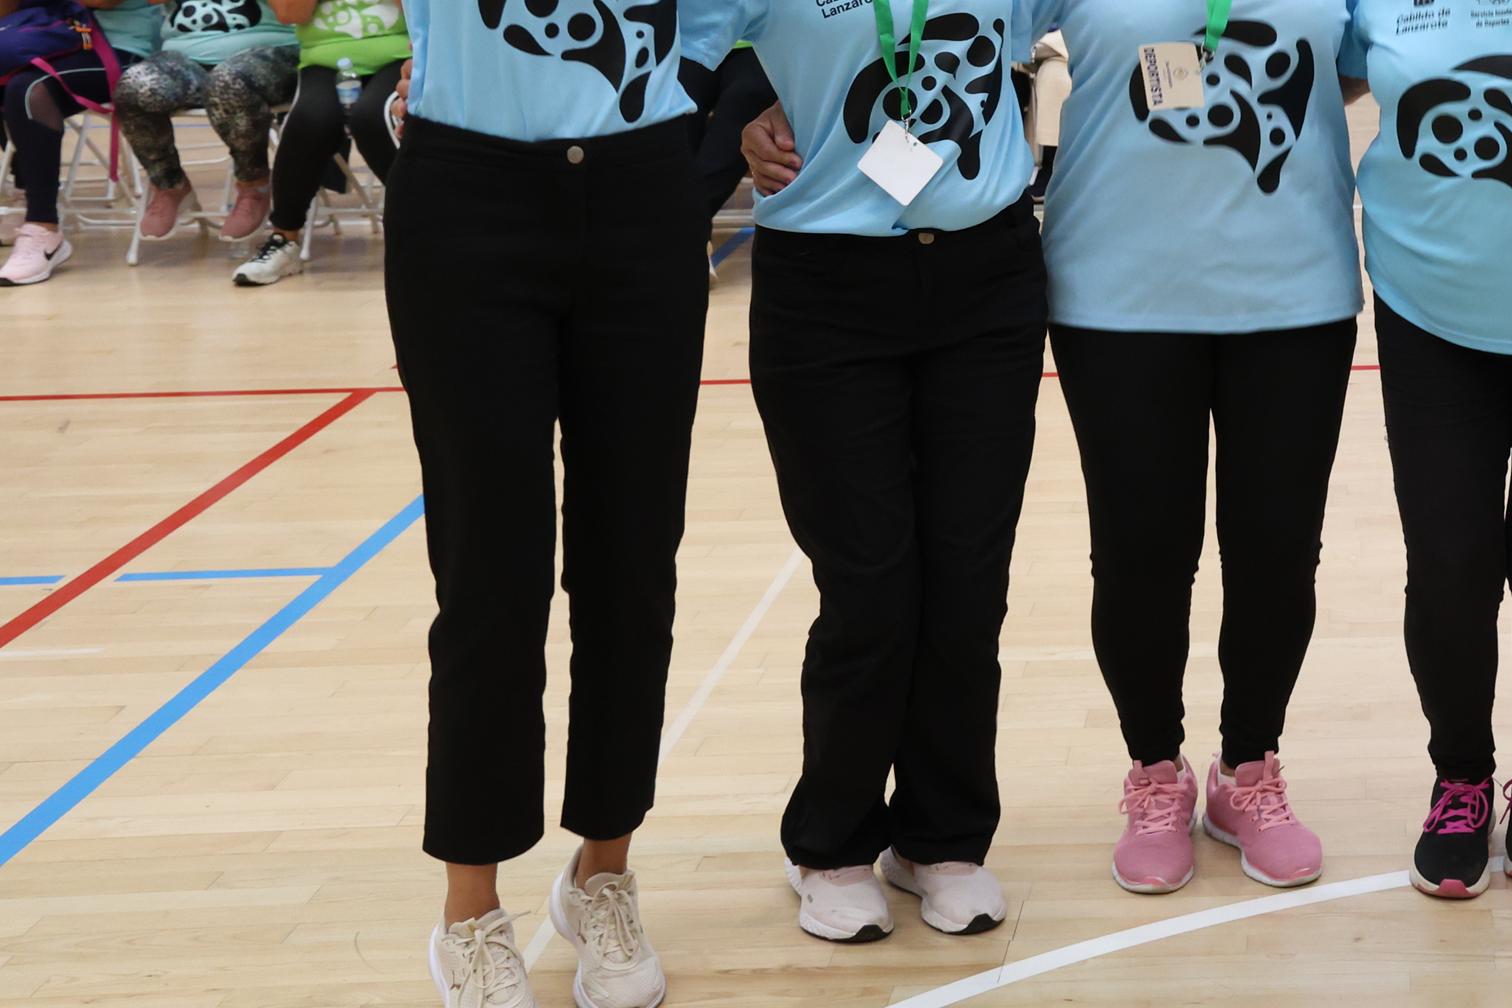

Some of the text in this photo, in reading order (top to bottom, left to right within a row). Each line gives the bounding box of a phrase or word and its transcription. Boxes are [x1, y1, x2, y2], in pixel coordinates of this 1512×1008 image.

[1396, 7, 1451, 24] Cabildo de
[1396, 20, 1448, 36] Lanzarote
